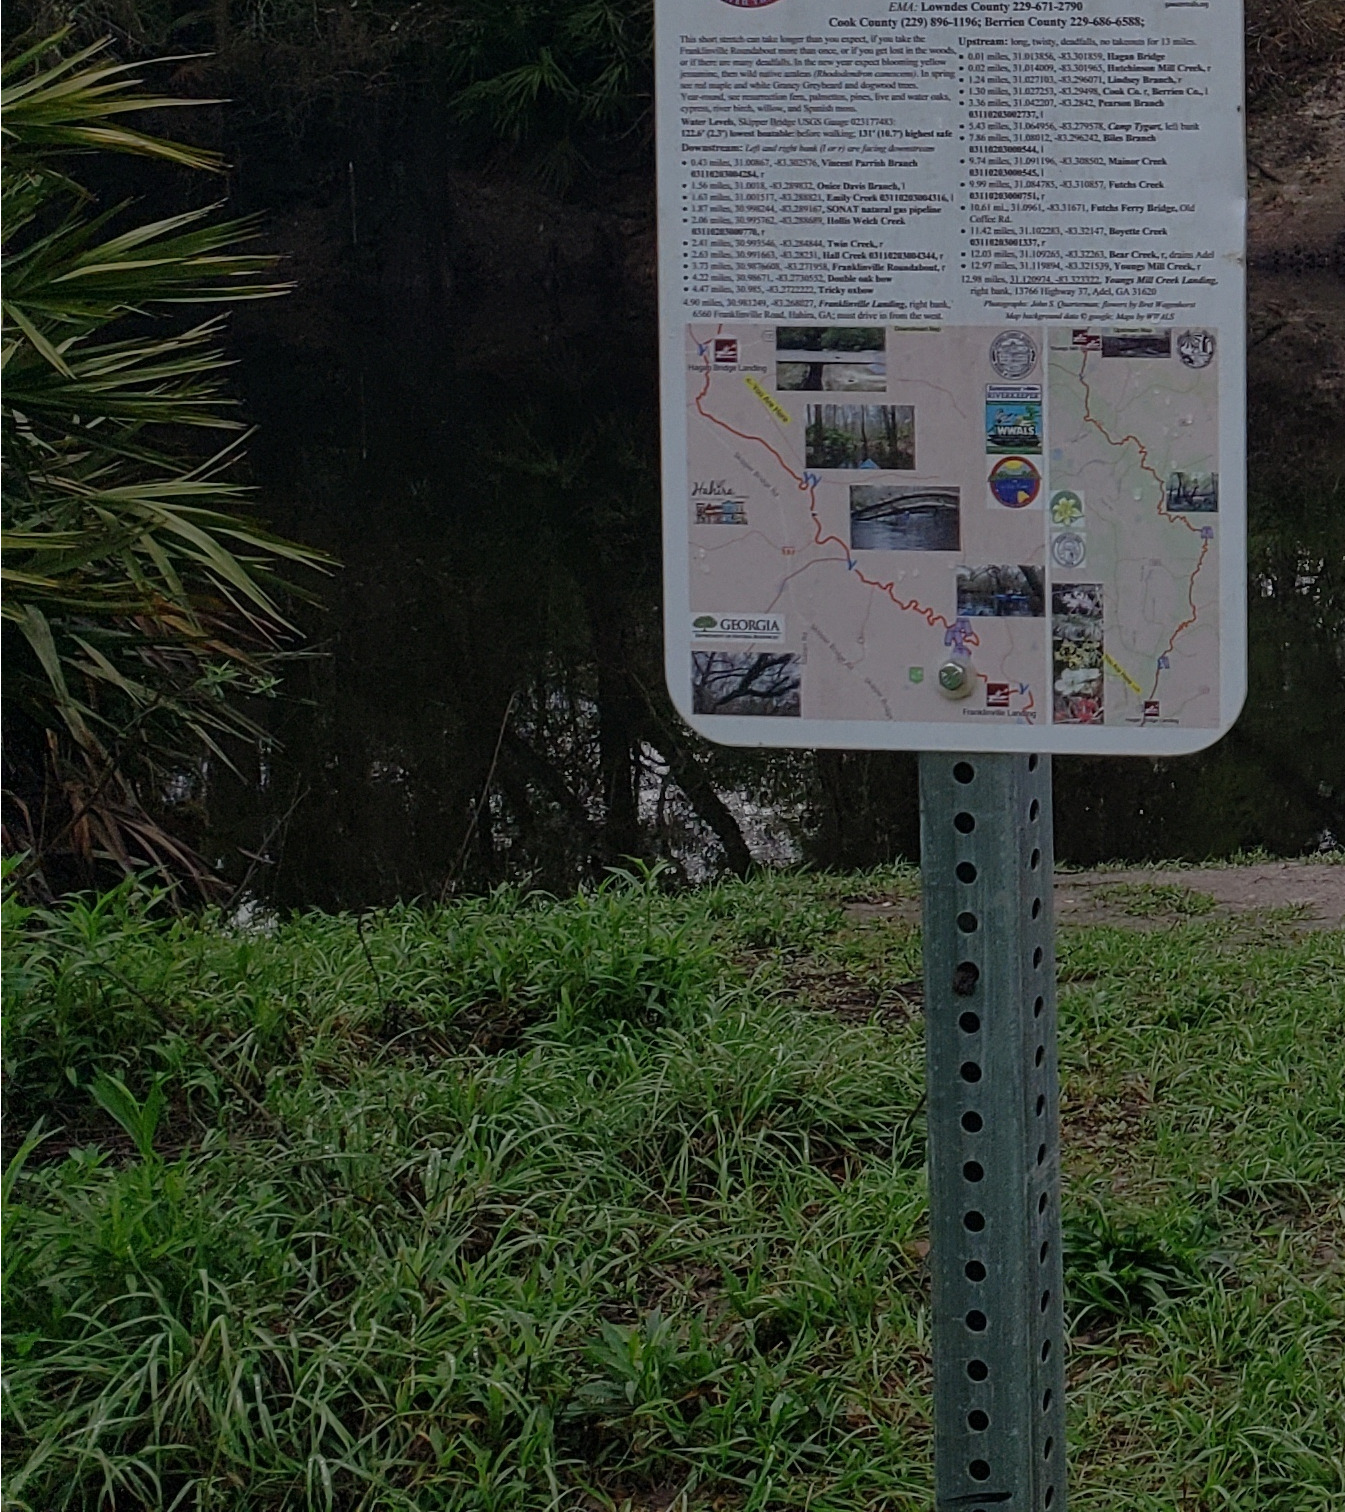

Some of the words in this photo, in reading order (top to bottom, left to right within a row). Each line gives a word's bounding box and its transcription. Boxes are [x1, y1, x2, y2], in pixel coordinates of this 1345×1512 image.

[888, 1, 917, 11] EMA:
[920, 2, 967, 11] Lowndes
[970, 1, 1010, 13] County
[1012, 1, 1083, 11] 229-671-2790
[828, 17, 856, 26] Cook
[859, 17, 897, 28] County
[900, 17, 927, 28] (229)
[930, 17, 981, 26] 896-1196;
[984, 17, 1024, 26] Berrien
[1027, 16, 1067, 28] County
[1070, 16, 1144, 26] 229-686-6588;
[958, 37, 1008, 47] Upstream:
[1106, 52, 1134, 61] Hagan
[1136, 52, 1165, 61] Bridge
[1104, 276, 1134, 285] Youngs
[969, 286, 989, 296] right
[1040, 287, 1075, 296] Highway
[1091, 287, 1114, 296] Adel,
[1115, 287, 1130, 295] GA
[1132, 287, 1157, 295] 31620
[688, 363, 712, 373] Hagan
[712, 364, 736, 372] Bridge
[737, 364, 767, 373] Landing
[997, 425, 1035, 436] WWALS
[720, 619, 780, 631] GEORGIA
[1006, 708, 1036, 719] Landing
